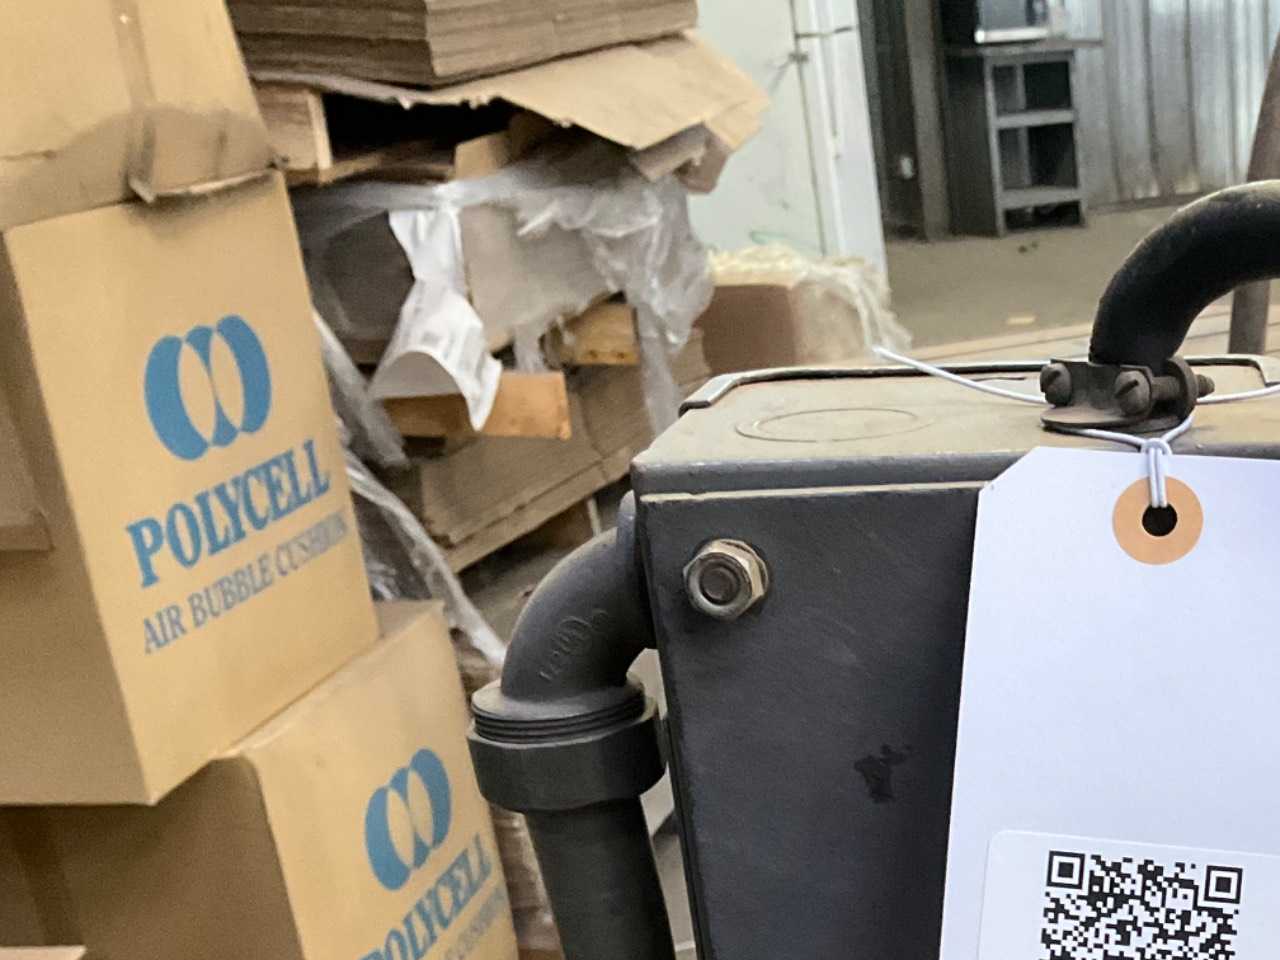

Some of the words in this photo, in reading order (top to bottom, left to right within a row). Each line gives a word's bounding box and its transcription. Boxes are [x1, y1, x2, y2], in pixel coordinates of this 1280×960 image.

[125, 439, 331, 589] POLYCELL
[143, 604, 187, 655] AIR
[188, 552, 274, 629] BUBBLE
